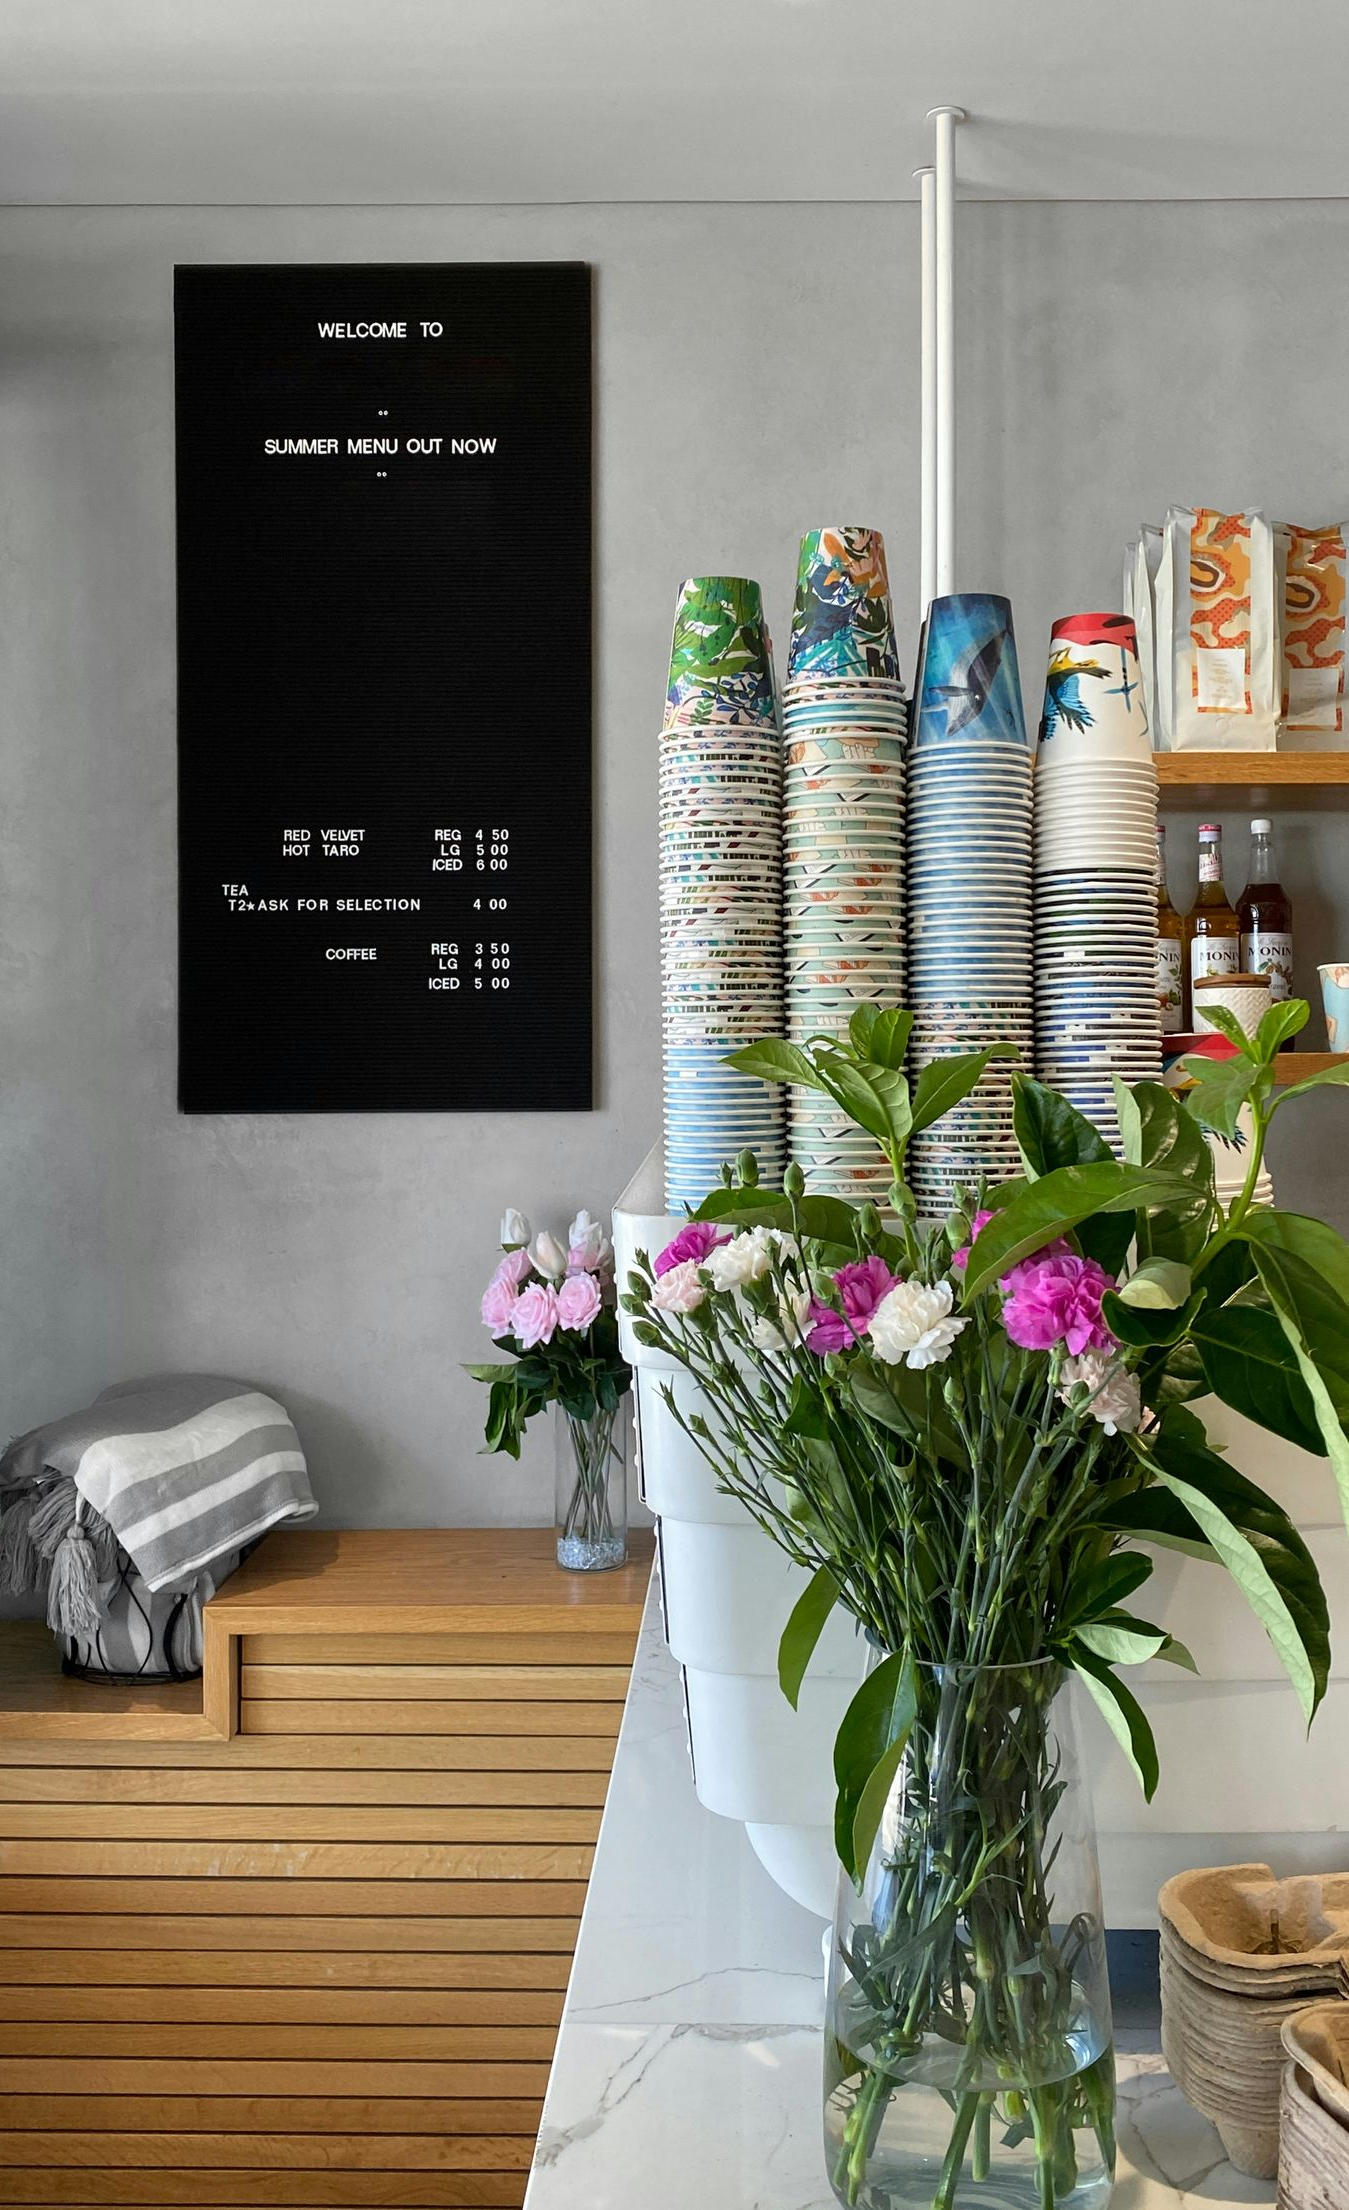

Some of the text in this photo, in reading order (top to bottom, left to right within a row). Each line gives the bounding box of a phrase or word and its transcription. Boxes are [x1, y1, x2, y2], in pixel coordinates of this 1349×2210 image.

[317, 321, 444, 339] WELCOME TO
[264, 437, 498, 455] SUMMER MENU OUT NOW
[283, 829, 366, 842] RED VELVET
[434, 828, 510, 842] REG 4 50
[282, 844, 360, 857] HOT TARO
[440, 843, 509, 857] LG 5 00
[432, 857, 508, 872] ICED 6 00
[221, 884, 249, 897] TEA
[297, 898, 329, 911] FOR
[336, 898, 421, 912] SELECTION
[473, 898, 508, 911] 4 00
[325, 947, 378, 961] COFFEE
[431, 942, 510, 956] REG 3 50
[438, 957, 511, 970] LG 4 00
[1200, 952, 1237, 961] MONI
[428, 977, 510, 990] ICED 5 00
